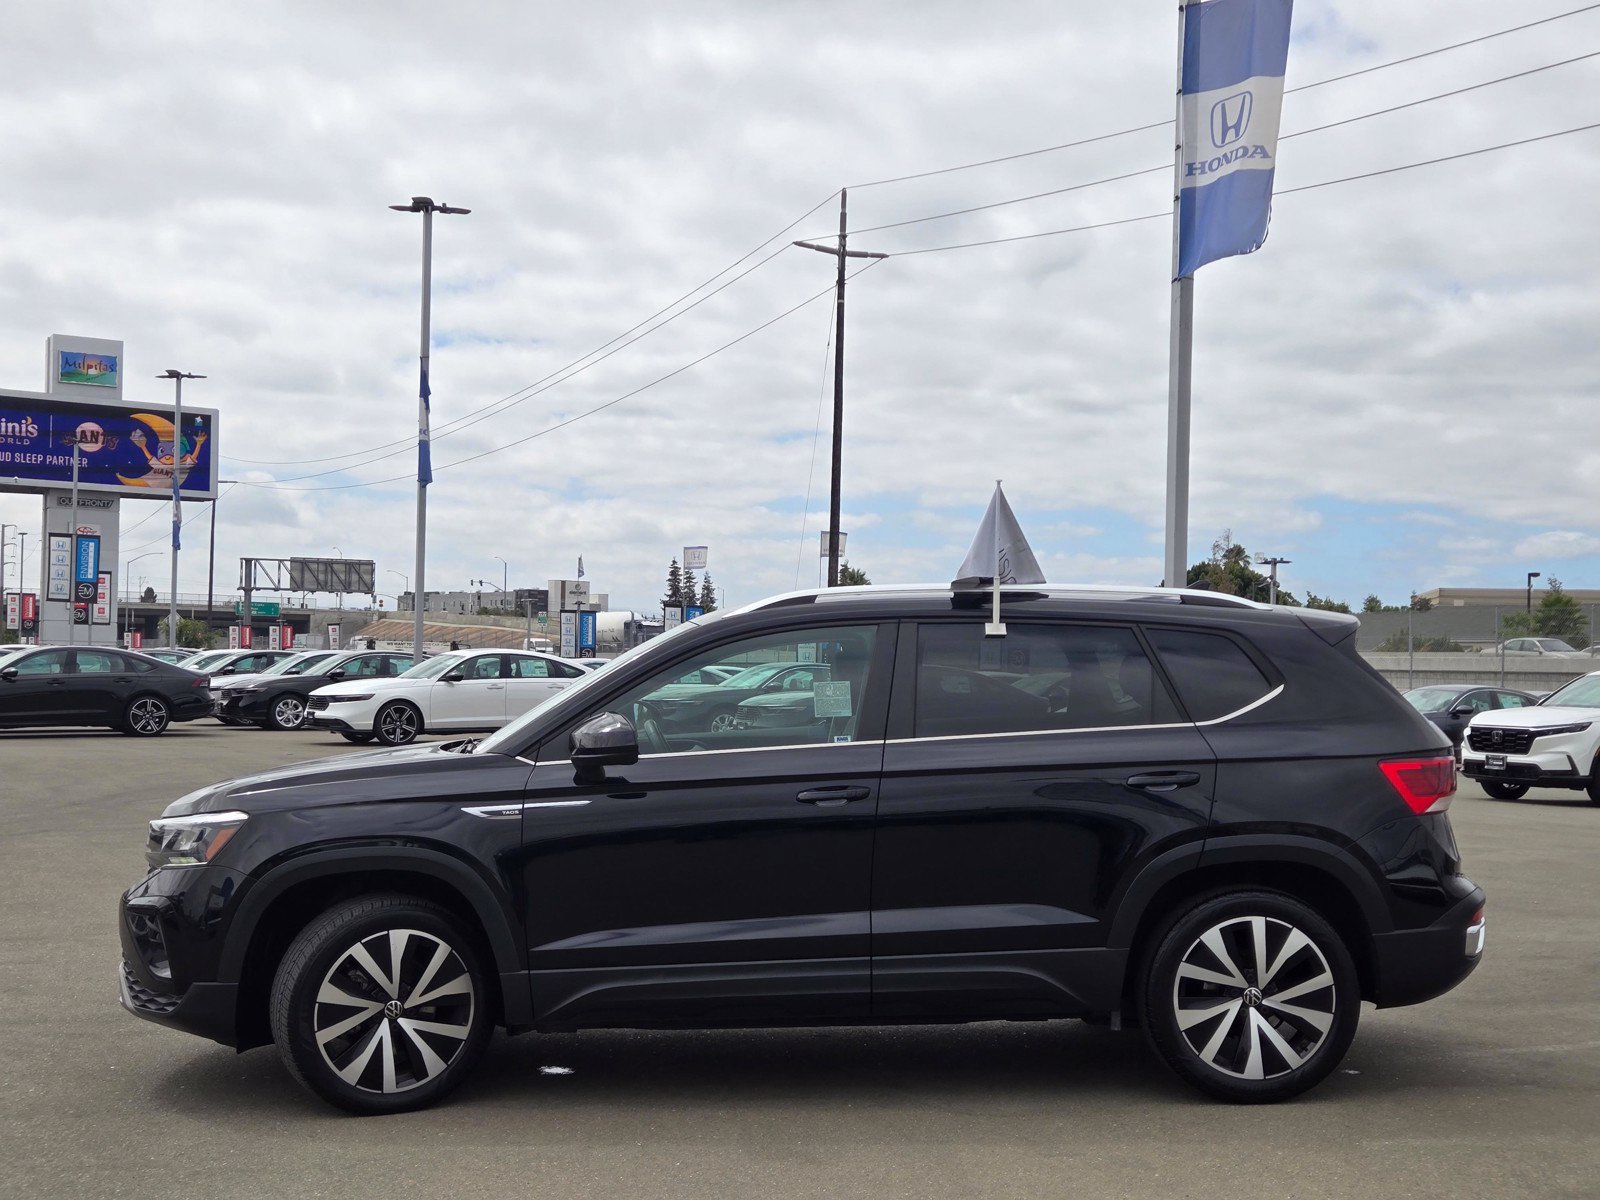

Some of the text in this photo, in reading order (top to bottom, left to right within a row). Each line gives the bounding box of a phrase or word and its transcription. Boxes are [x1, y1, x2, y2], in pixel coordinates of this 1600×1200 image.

[1185, 144, 1272, 177] HONDA
[64, 355, 115, 376] Milpitas
[14, 452, 43, 464] SLEEP
[80, 541, 89, 579] ENVISION
